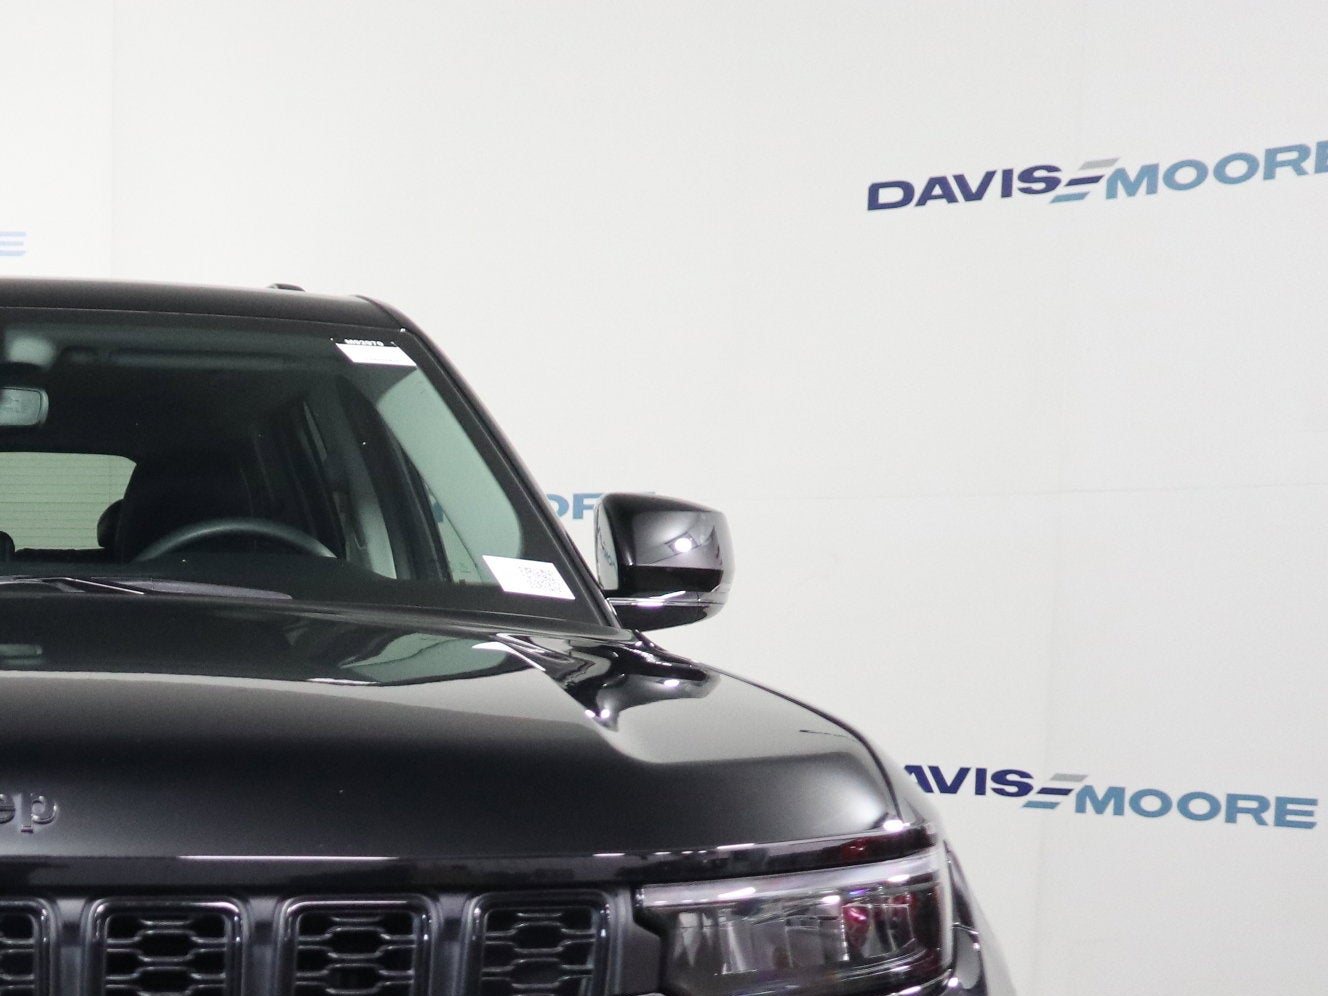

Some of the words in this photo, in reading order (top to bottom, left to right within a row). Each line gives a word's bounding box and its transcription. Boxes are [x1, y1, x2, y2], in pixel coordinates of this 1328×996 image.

[867, 164, 1063, 211] DAVIS
[903, 764, 1035, 798] AVIS
[1074, 784, 1319, 829] MOORE
